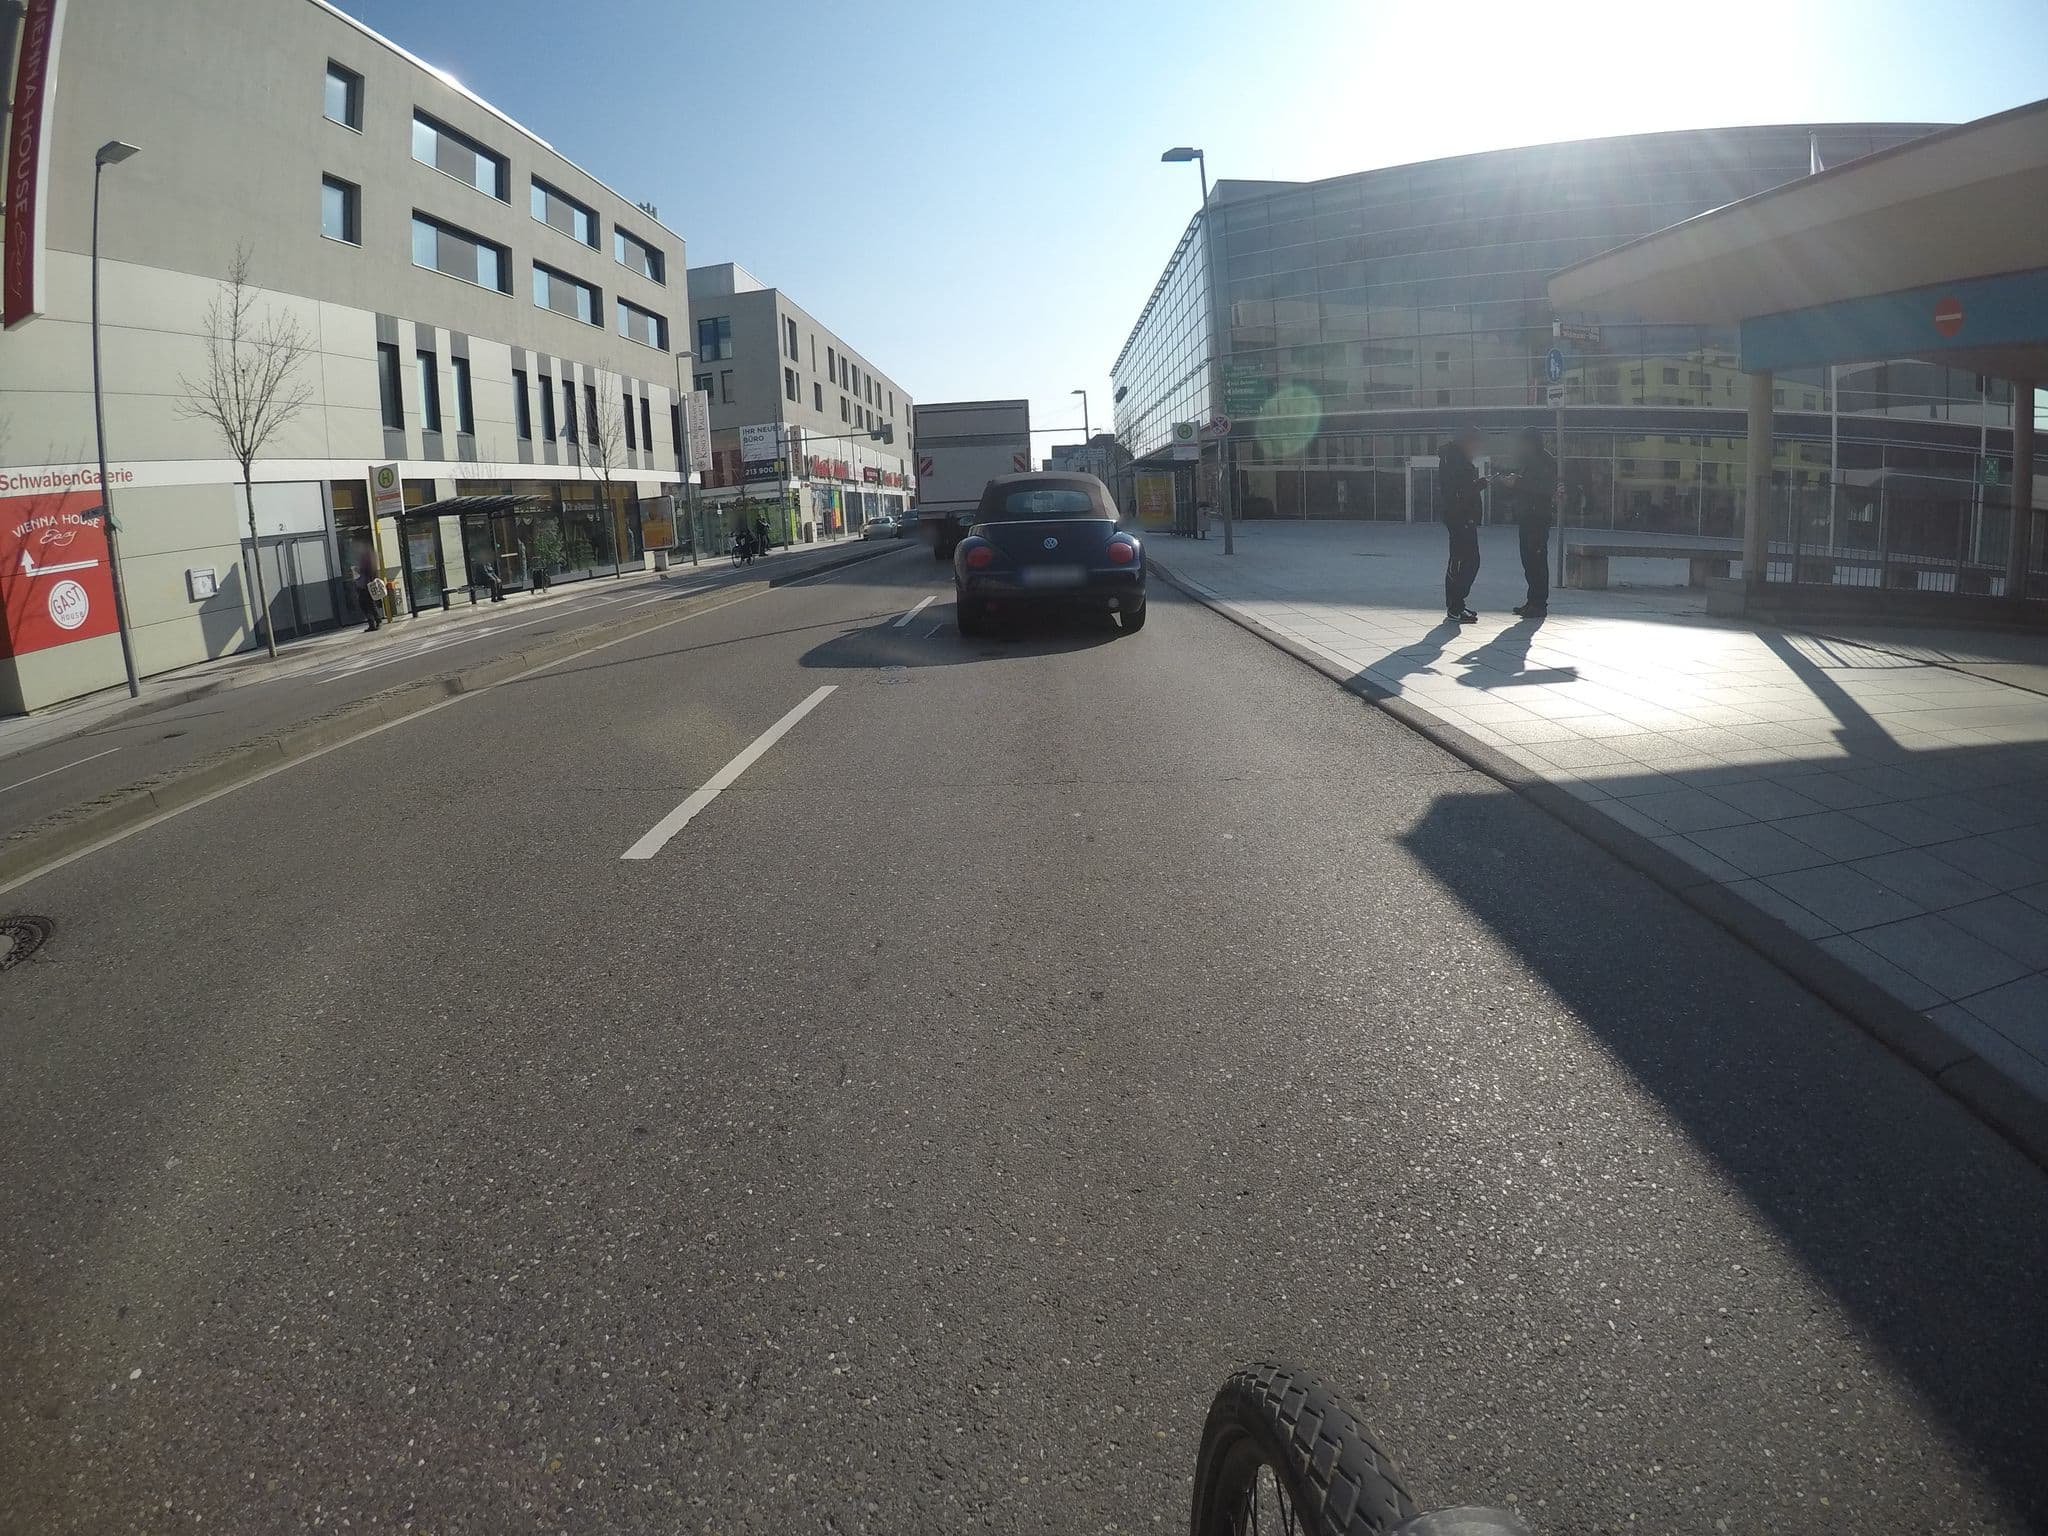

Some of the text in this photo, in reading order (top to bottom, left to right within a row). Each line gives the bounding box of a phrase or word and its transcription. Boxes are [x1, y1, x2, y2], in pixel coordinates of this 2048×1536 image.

[14, 109, 34, 217] HOUSE
[742, 428, 755, 436] IHR
[0, 468, 133, 491] SchwabenGaerie
[745, 468, 757, 476] 213
[12, 514, 101, 538] VIENNA HOUSE
[40, 528, 77, 547] Easy
[53, 585, 81, 615] GAST
